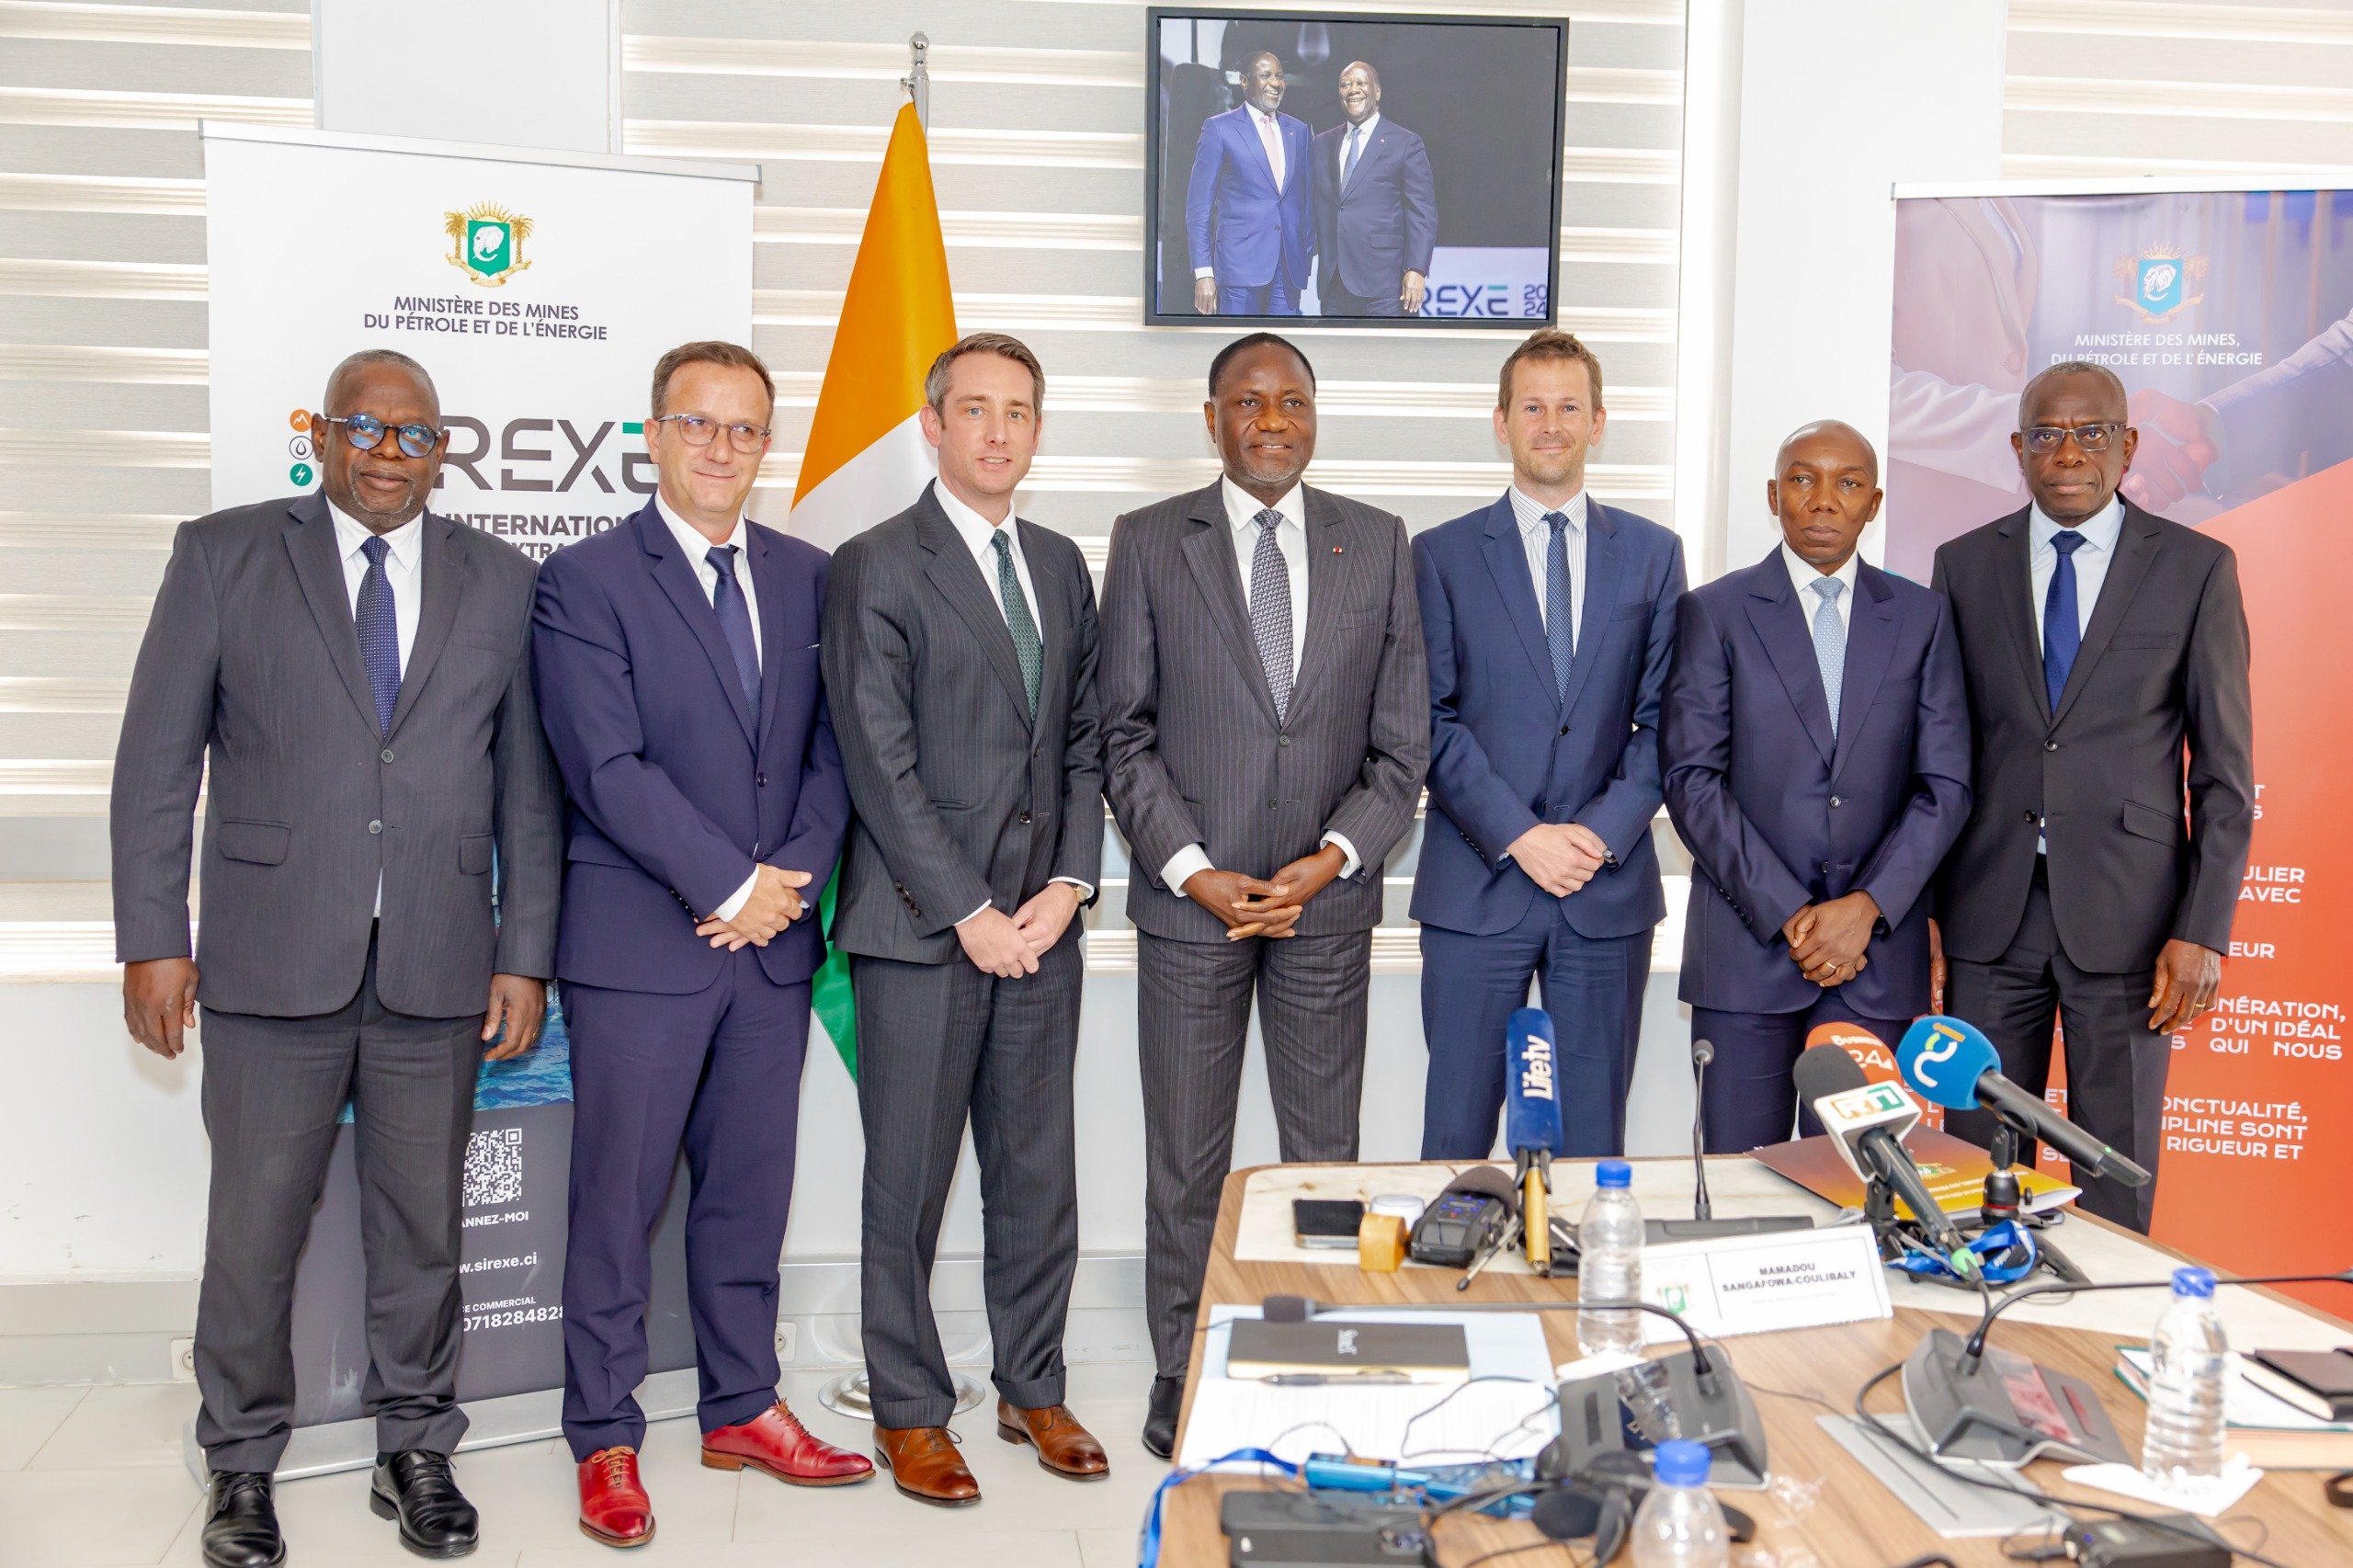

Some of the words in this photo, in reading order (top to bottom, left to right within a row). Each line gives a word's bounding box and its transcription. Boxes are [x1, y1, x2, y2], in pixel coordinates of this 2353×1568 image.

[394, 295, 483, 315] MINISTÈRE
[489, 301, 521, 317] DES
[526, 303, 579, 321] MINES
[364, 313, 390, 329] DU
[395, 312, 468, 334] PÉTROLE
[473, 319, 491, 335] ET
[495, 322, 518, 336] DE
[523, 319, 608, 341] L'ÉNERGIE
[2075, 331, 2151, 347] MINISTÈRE
[2155, 335, 2184, 347] DES
[2188, 334, 2241, 348] MINES,
[2079, 350, 2139, 366] PÉTROLE
[2143, 353, 2158, 365] ET
[2163, 353, 2182, 365] DE
[446, 513, 627, 536] NTERNATIO
[2238, 886, 2302, 904] AVEC
[2211, 1017, 2268, 1036] D'UN
[2274, 1019, 2341, 1040] IDÉAL
[2210, 1038, 2249, 1054] QUI
[2273, 1040, 2343, 1061] NOUS
[2240, 1121, 2308, 1141] SONT
[2166, 1136, 2268, 1158] RIGUEUR
[2274, 1143, 2303, 1160] ET
[1759, 1263, 1816, 1277] MAMADOU
[472, 1296, 537, 1312] COMMERCIAL
